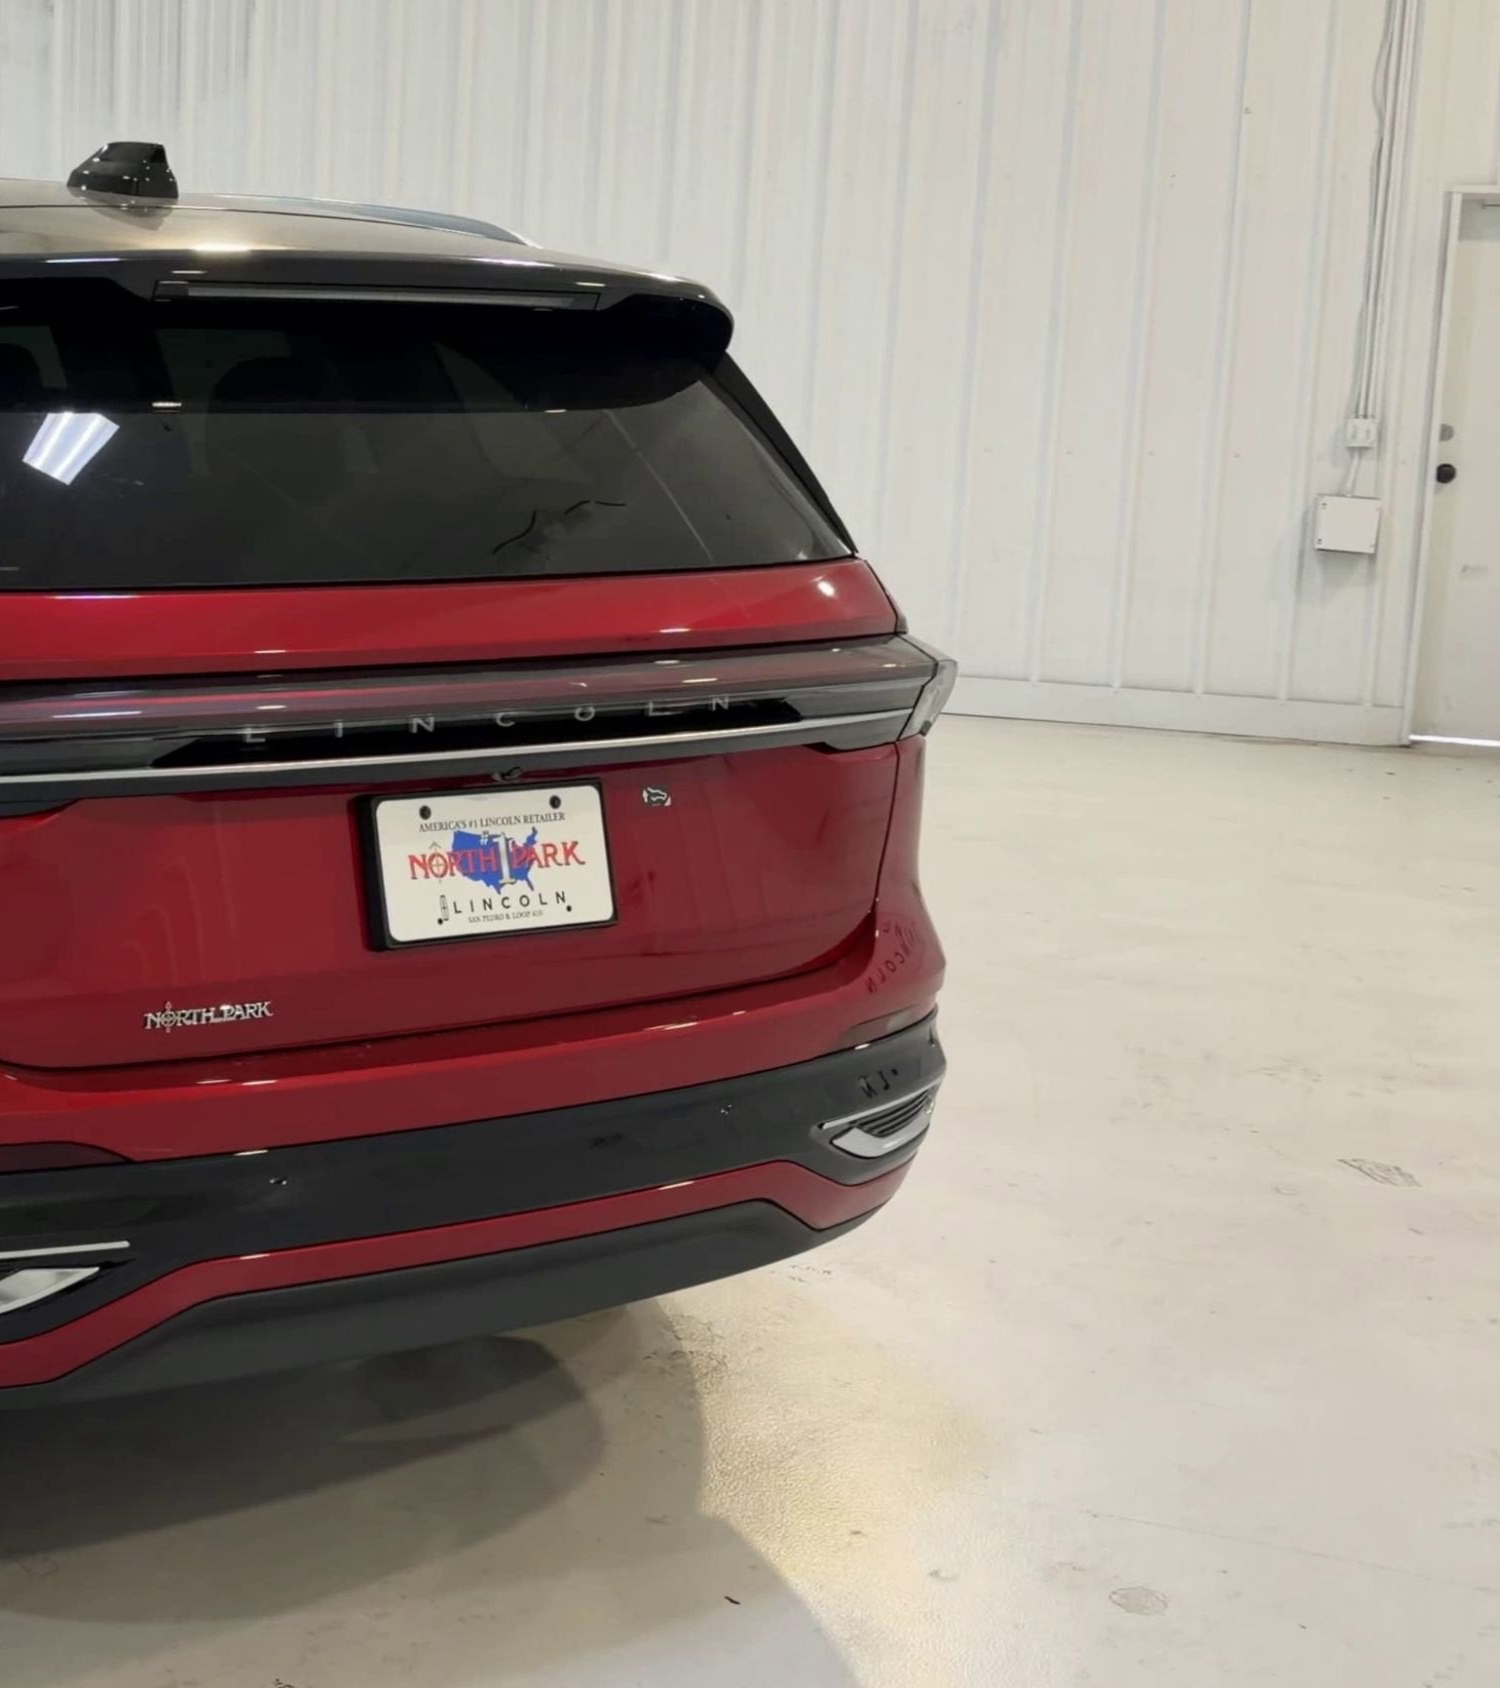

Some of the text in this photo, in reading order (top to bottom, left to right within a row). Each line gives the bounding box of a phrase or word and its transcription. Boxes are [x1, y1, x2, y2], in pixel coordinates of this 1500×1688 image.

[242, 695, 731, 744] LINCOLN
[418, 812, 565, 833] AMERICA'S #1 LINCOLN RETAILER
[408, 841, 586, 880] NORTH PARK
[453, 891, 566, 914] LINCOLN
[144, 1002, 274, 1031] NORTH PARK
